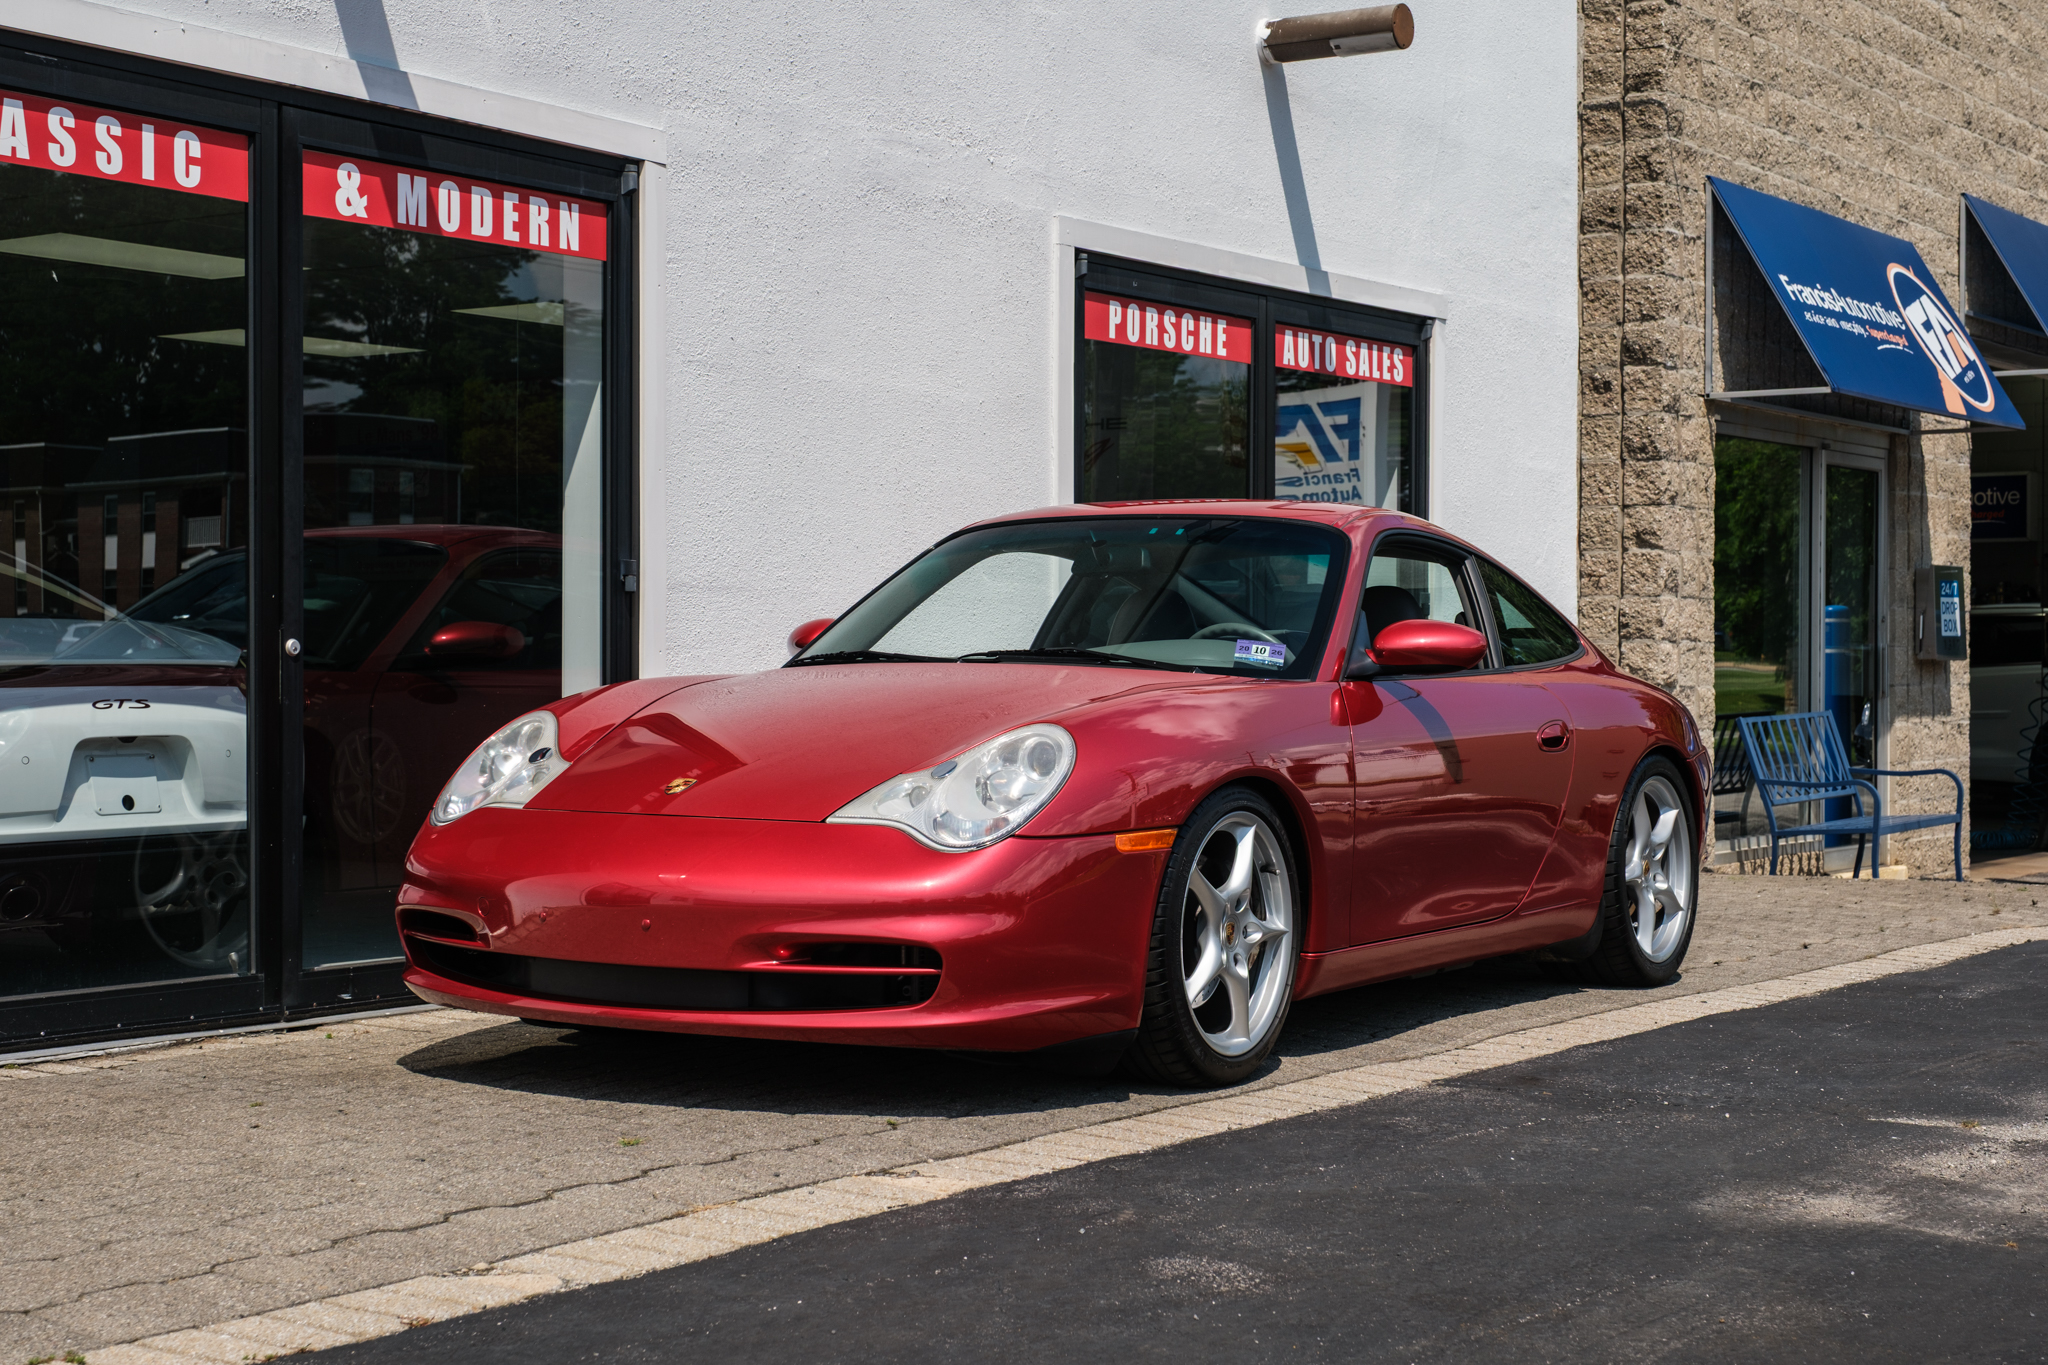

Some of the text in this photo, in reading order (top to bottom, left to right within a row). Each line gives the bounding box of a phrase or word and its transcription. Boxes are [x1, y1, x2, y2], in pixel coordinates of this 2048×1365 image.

[0, 97, 201, 188] ASSIC
[335, 162, 581, 252] & MODERN
[1108, 300, 1227, 357] PORSCHE
[1282, 329, 1404, 383] AUTO SALES
[1971, 486, 2021, 506] otive
[1941, 583, 1958, 596] 24/7
[1941, 601, 1959, 616] DROP
[1943, 618, 1958, 633] BOX
[1253, 646, 1267, 655] 10
[92, 698, 151, 710] GTS
